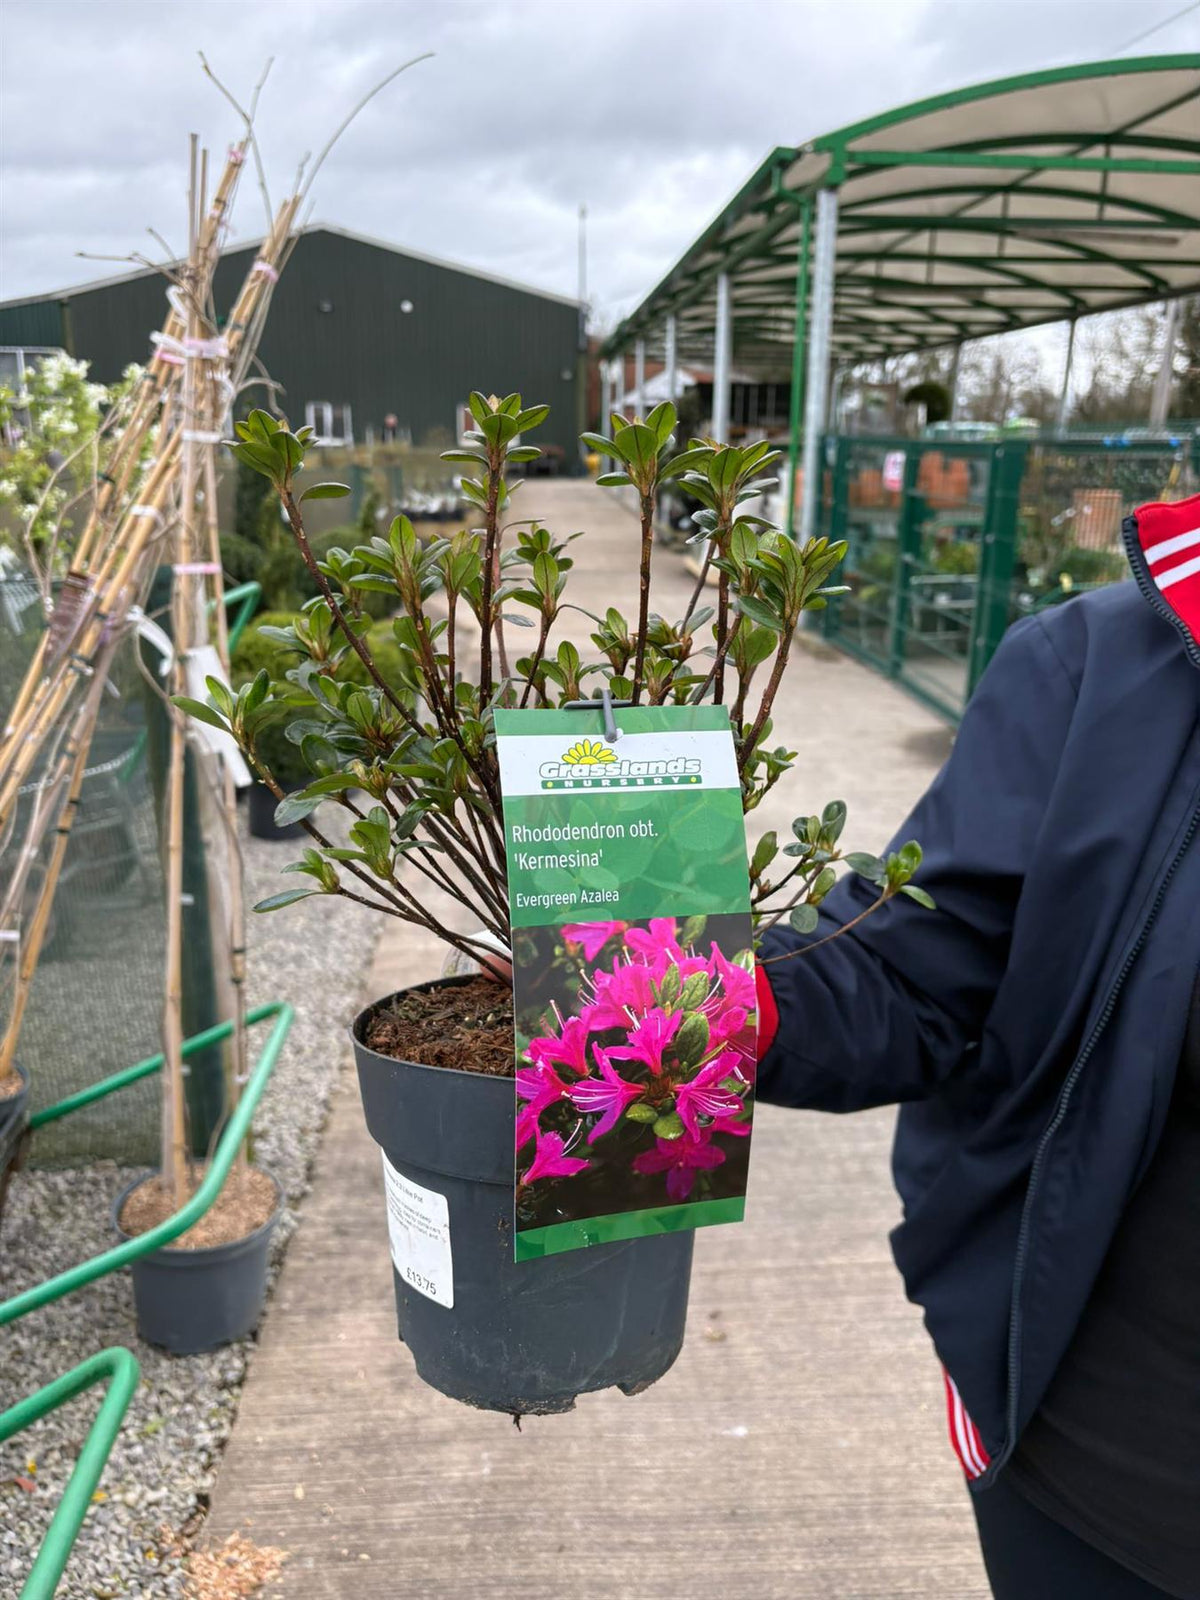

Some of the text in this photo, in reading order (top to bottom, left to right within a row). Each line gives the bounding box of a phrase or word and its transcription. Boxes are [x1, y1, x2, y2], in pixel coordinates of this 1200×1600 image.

[539, 757, 702, 779] Grasslands
[564, 776, 680, 788] NURSERY
[512, 820, 659, 843] Rhododendron obt.
[514, 849, 603, 870] 'Kermesina'
[516, 889, 619, 909] Evergreen Azalea
[406, 1266, 437, 1295] £13.75
